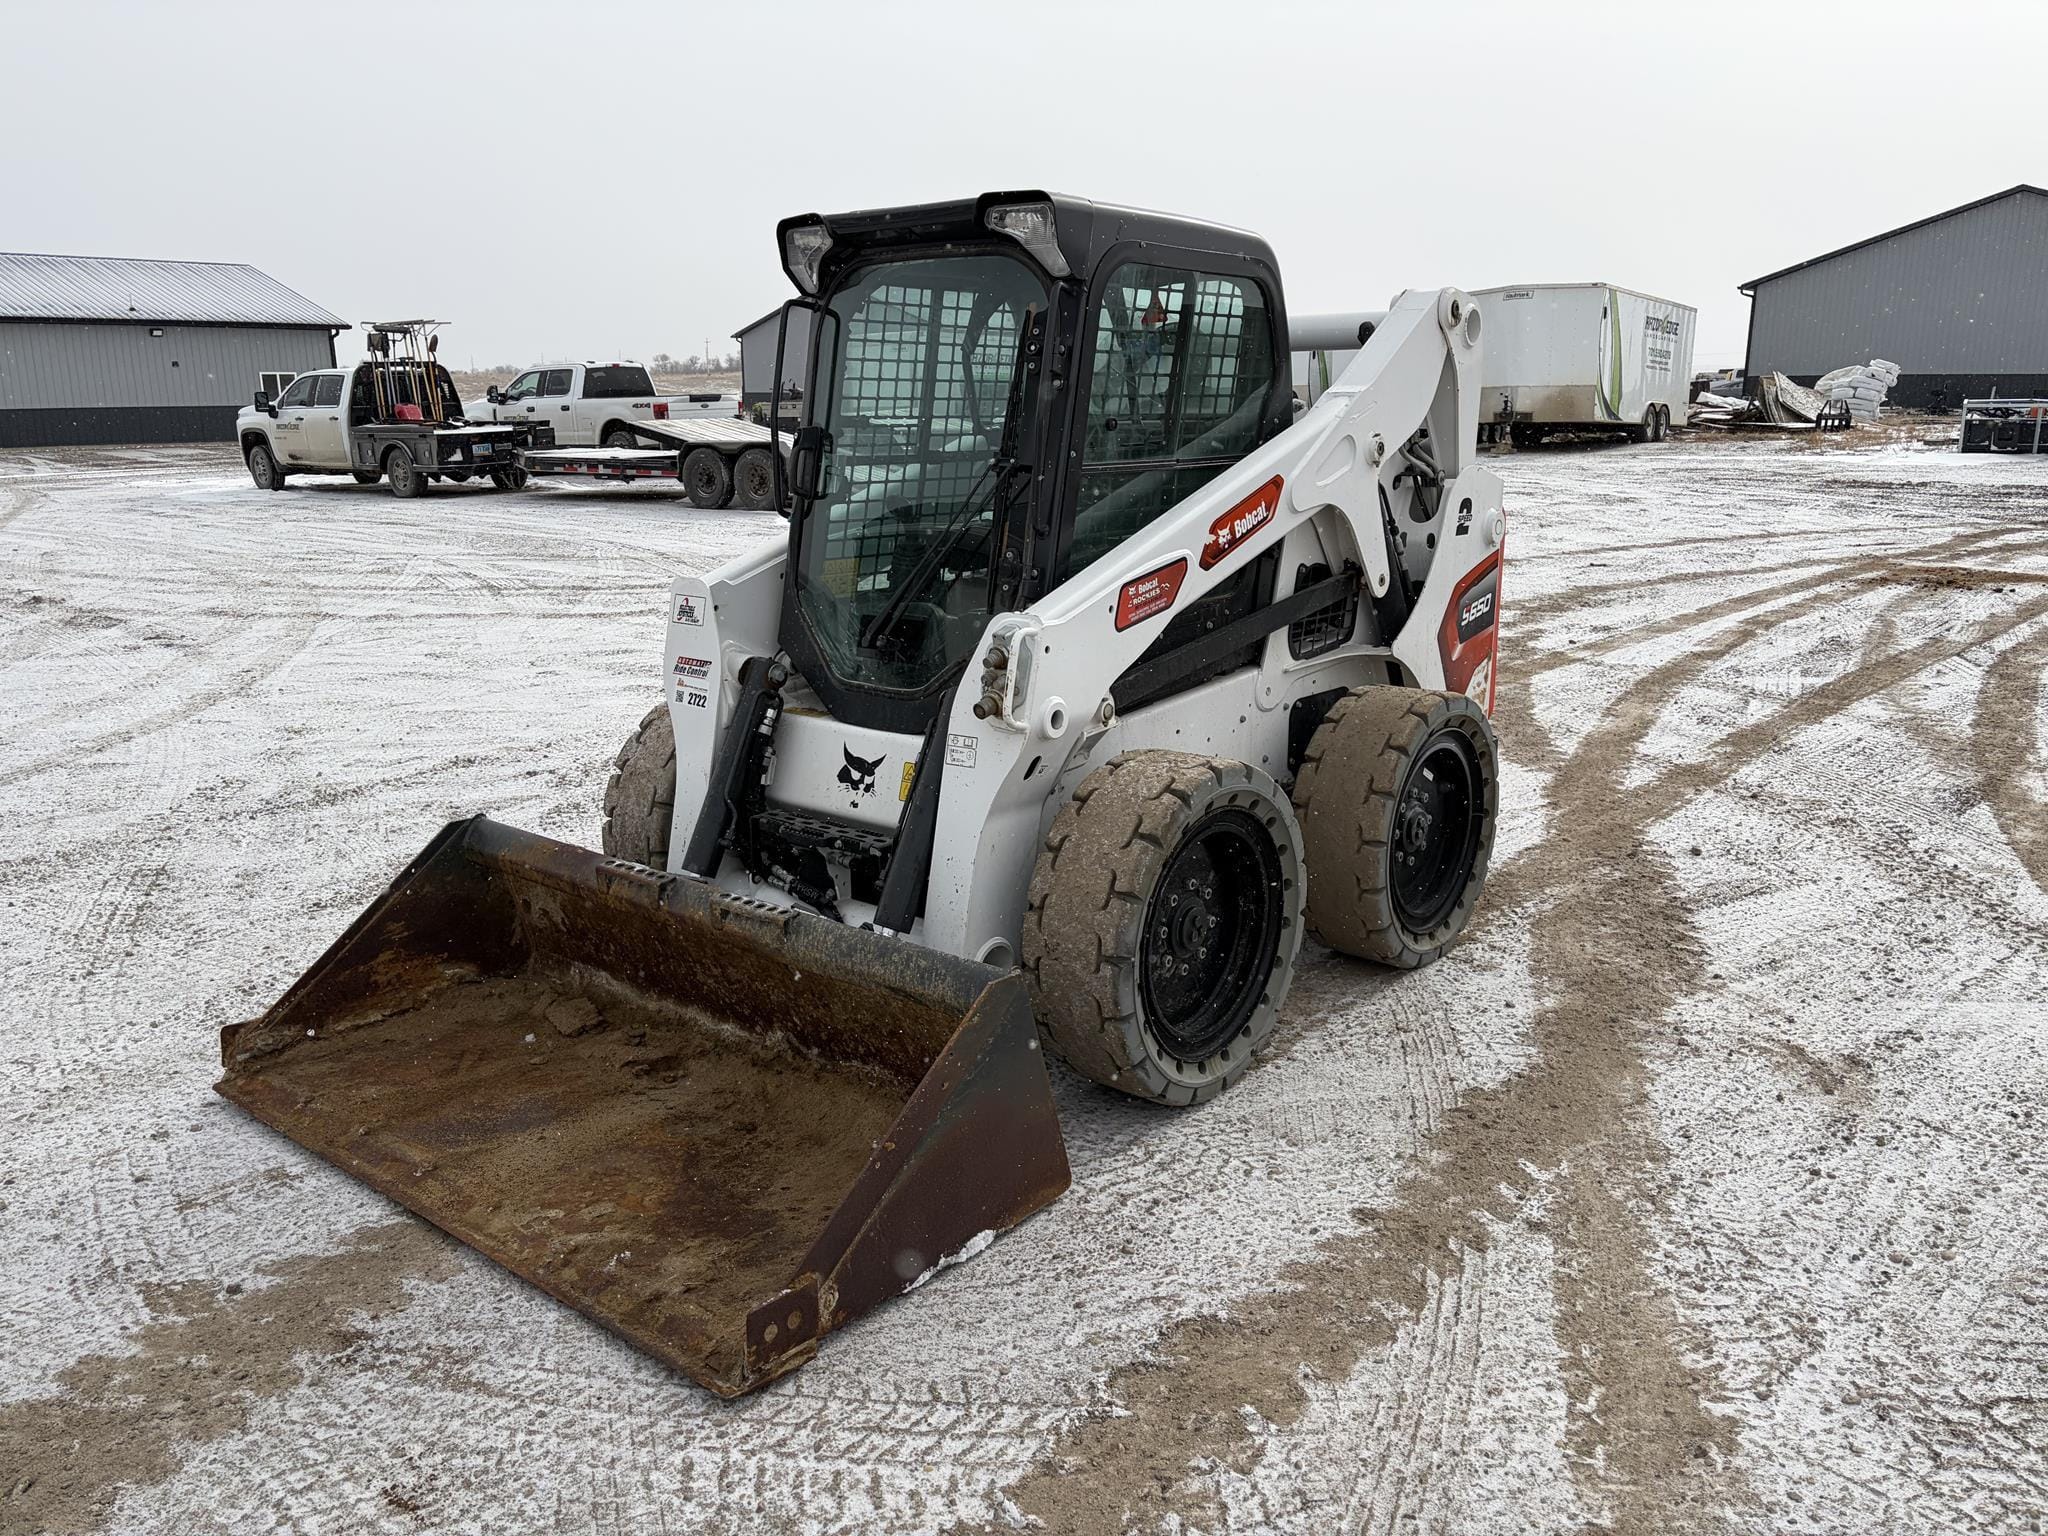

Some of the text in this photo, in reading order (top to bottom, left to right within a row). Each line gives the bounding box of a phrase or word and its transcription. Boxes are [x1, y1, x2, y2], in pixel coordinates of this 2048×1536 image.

[1234, 500, 1267, 539] Bobcat
[1455, 497, 1472, 536] 2
[1457, 514, 1472, 523] SPEED
[1138, 577, 1159, 594] Bobcat
[1133, 588, 1160, 605] ROCKIES
[1461, 593, 1492, 626] S650
[673, 664, 709, 677] Ride Control
[687, 692, 707, 708] 2722
